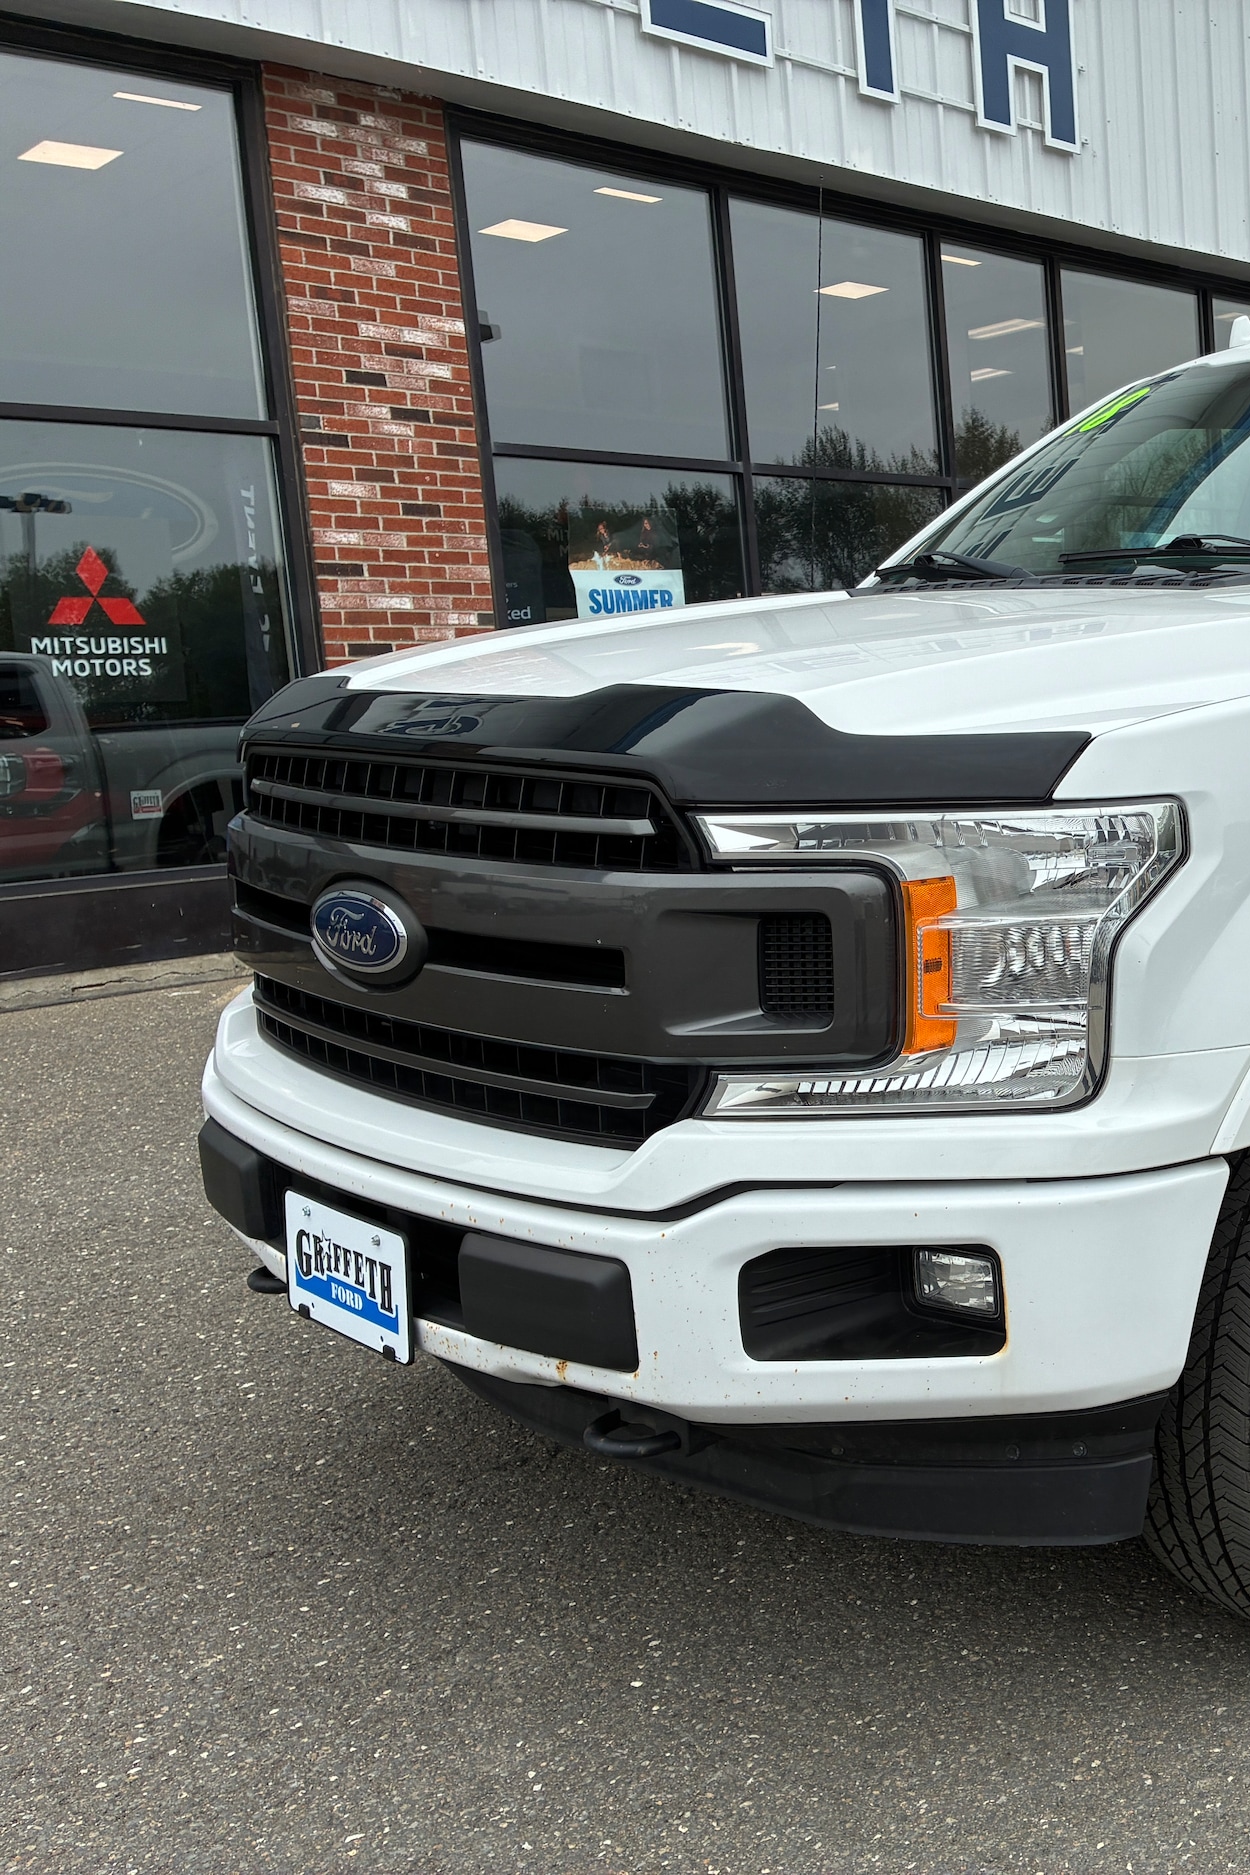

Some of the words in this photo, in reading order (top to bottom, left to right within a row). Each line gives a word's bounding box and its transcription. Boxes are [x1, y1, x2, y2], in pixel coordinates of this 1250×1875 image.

[588, 588, 673, 615] SUMMER
[31, 636, 167, 655] MITSUBISHI
[51, 658, 152, 677] MOTORS
[326, 906, 377, 956] Ford
[296, 1228, 394, 1315] GRIFFETH
[331, 1282, 364, 1311] FORD
